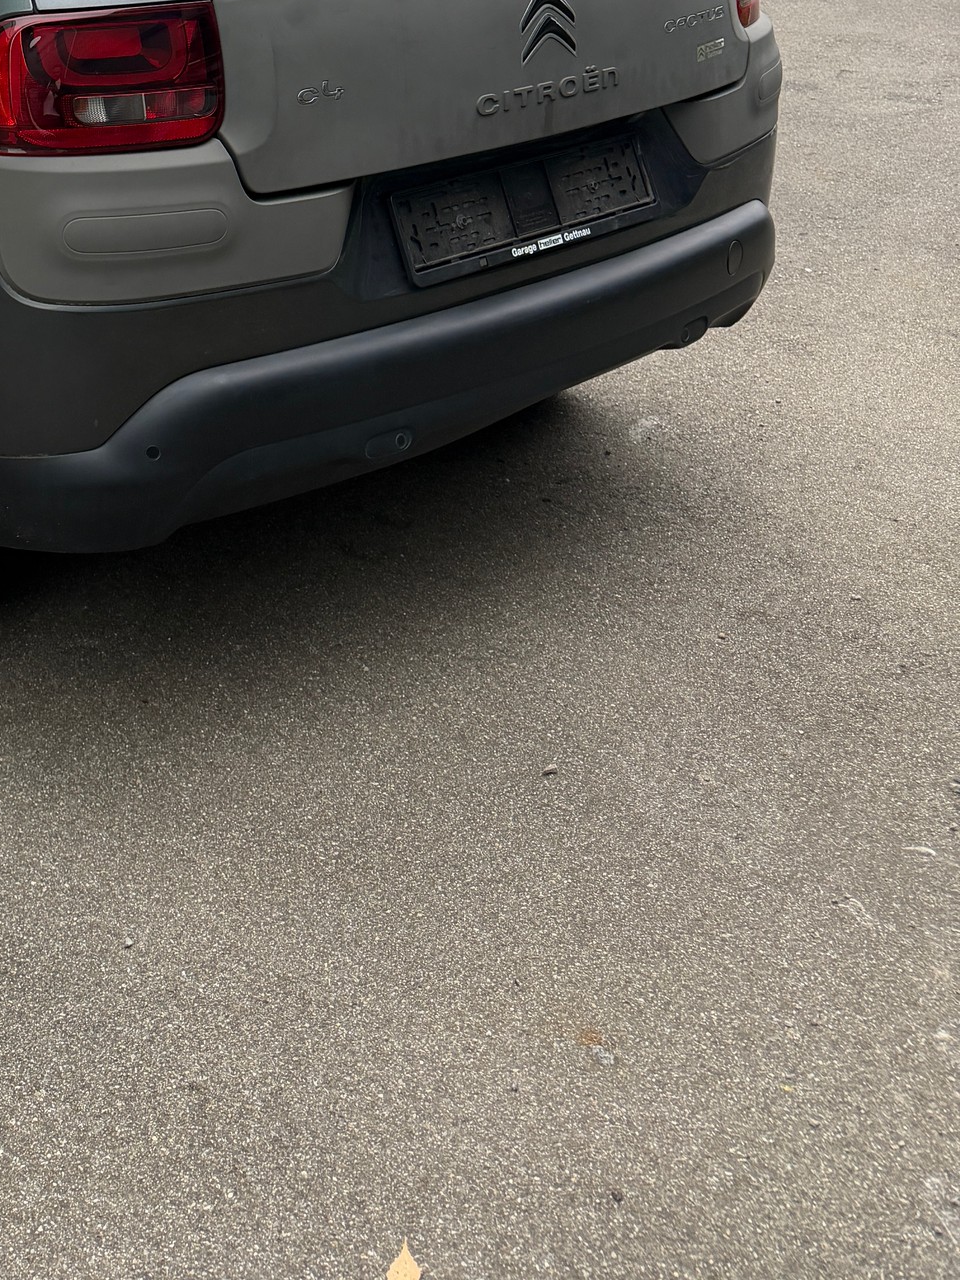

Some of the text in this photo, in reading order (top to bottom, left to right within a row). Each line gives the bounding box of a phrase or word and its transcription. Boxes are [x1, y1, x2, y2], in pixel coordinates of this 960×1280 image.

[664, 5, 724, 33] CACTUS
[297, 80, 345, 105] C4
[511, 243, 537, 257] Garage
[563, 227, 591, 241] Gettnau
